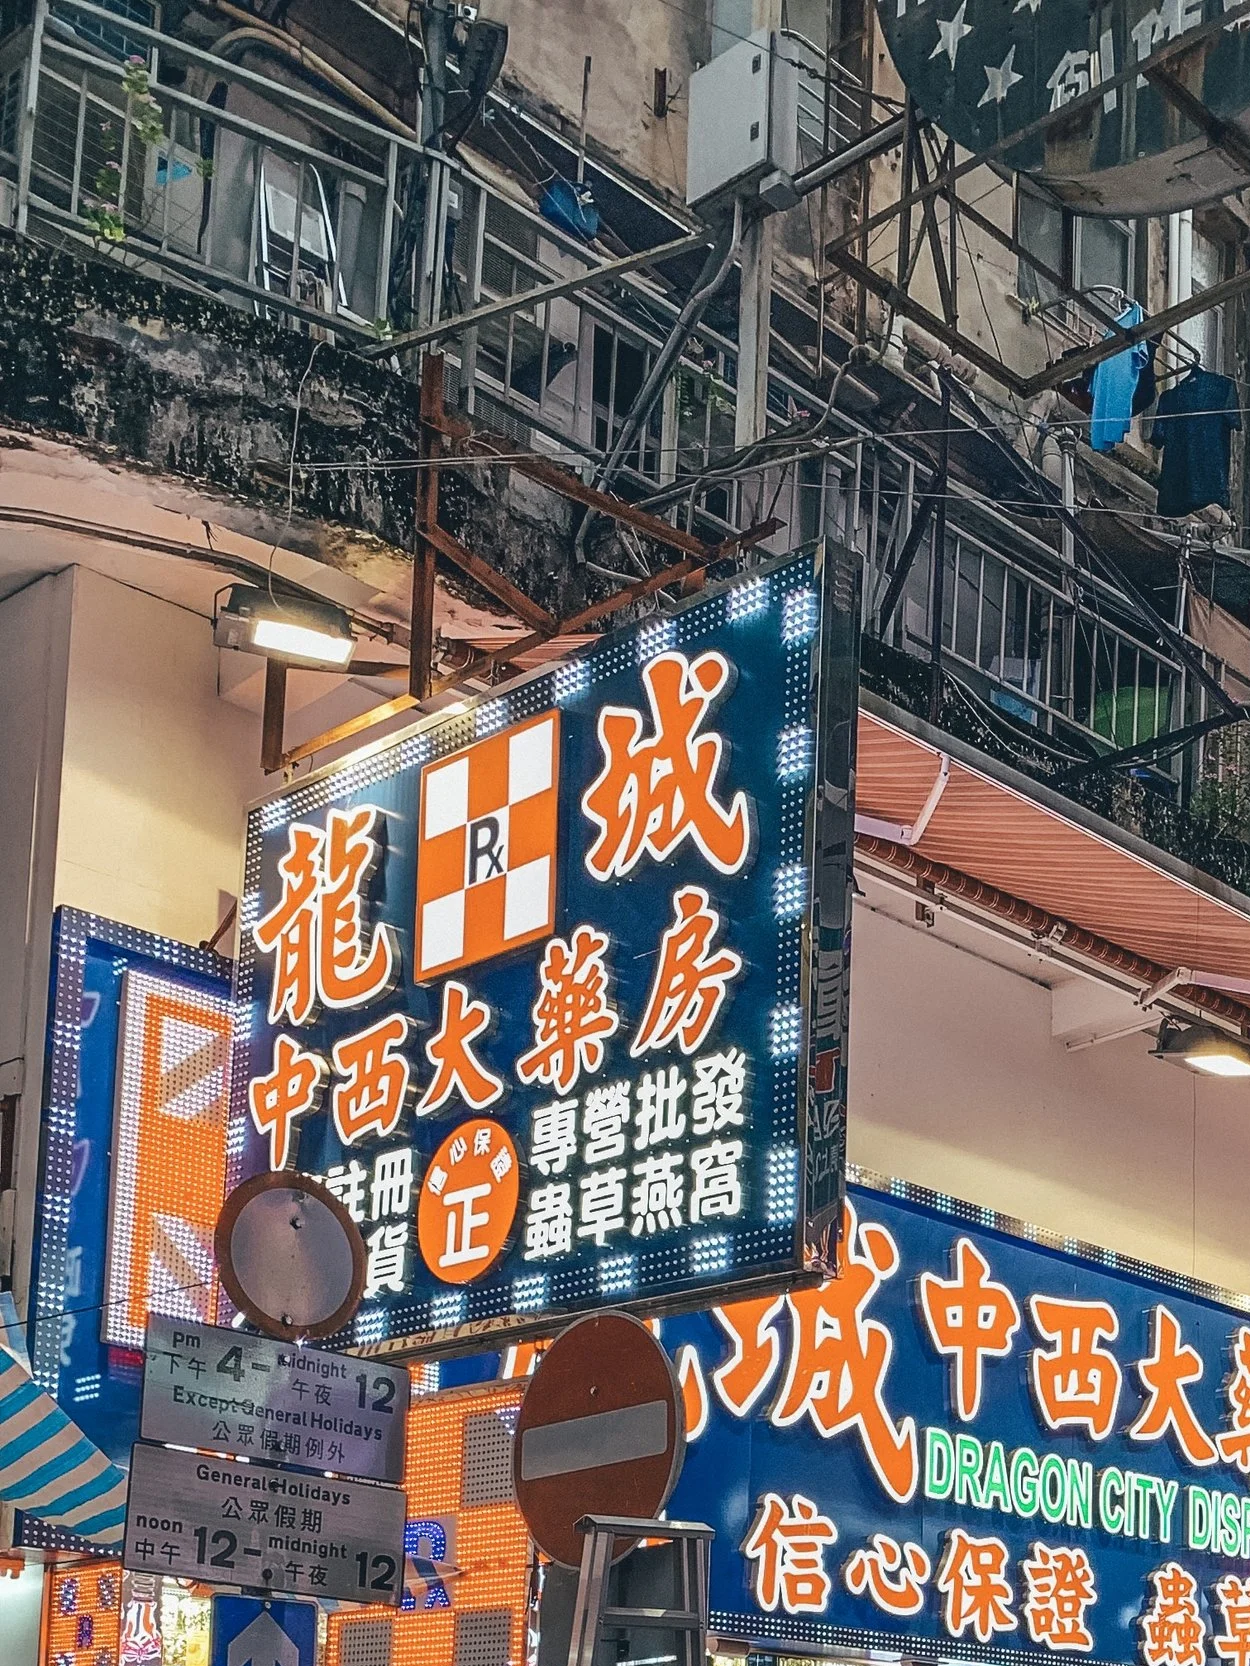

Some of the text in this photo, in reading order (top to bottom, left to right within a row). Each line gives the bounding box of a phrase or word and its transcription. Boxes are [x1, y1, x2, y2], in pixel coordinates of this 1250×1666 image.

[257, 651, 752, 1025] 龍 城
[249, 886, 744, 1171] 中西大藥房
[533, 1048, 746, 1175] 專營批發
[439, 1183, 492, 1268] 正
[525, 1140, 744, 1263] 蟲草燕窩
[162, 1351, 332, 1406] 下午 午夜
[172, 1331, 200, 1348] pm
[356, 1374, 396, 1414] 12
[172, 1385, 382, 1440] Except General Holidays
[212, 1420, 346, 1464] 公眾假期例外
[196, 1464, 350, 1506] General Holidays
[221, 1496, 322, 1534] 公眾假期
[923, 1426, 1094, 1529] DRAGON
[1098, 1466, 1180, 1545] CITY
[136, 1514, 182, 1534] noon
[268, 1535, 348, 1560] midnight
[356, 1552, 396, 1591] 12
[136, 1538, 329, 1586] 中午 午夜
[744, 1492, 1101, 1652] 信心保證
